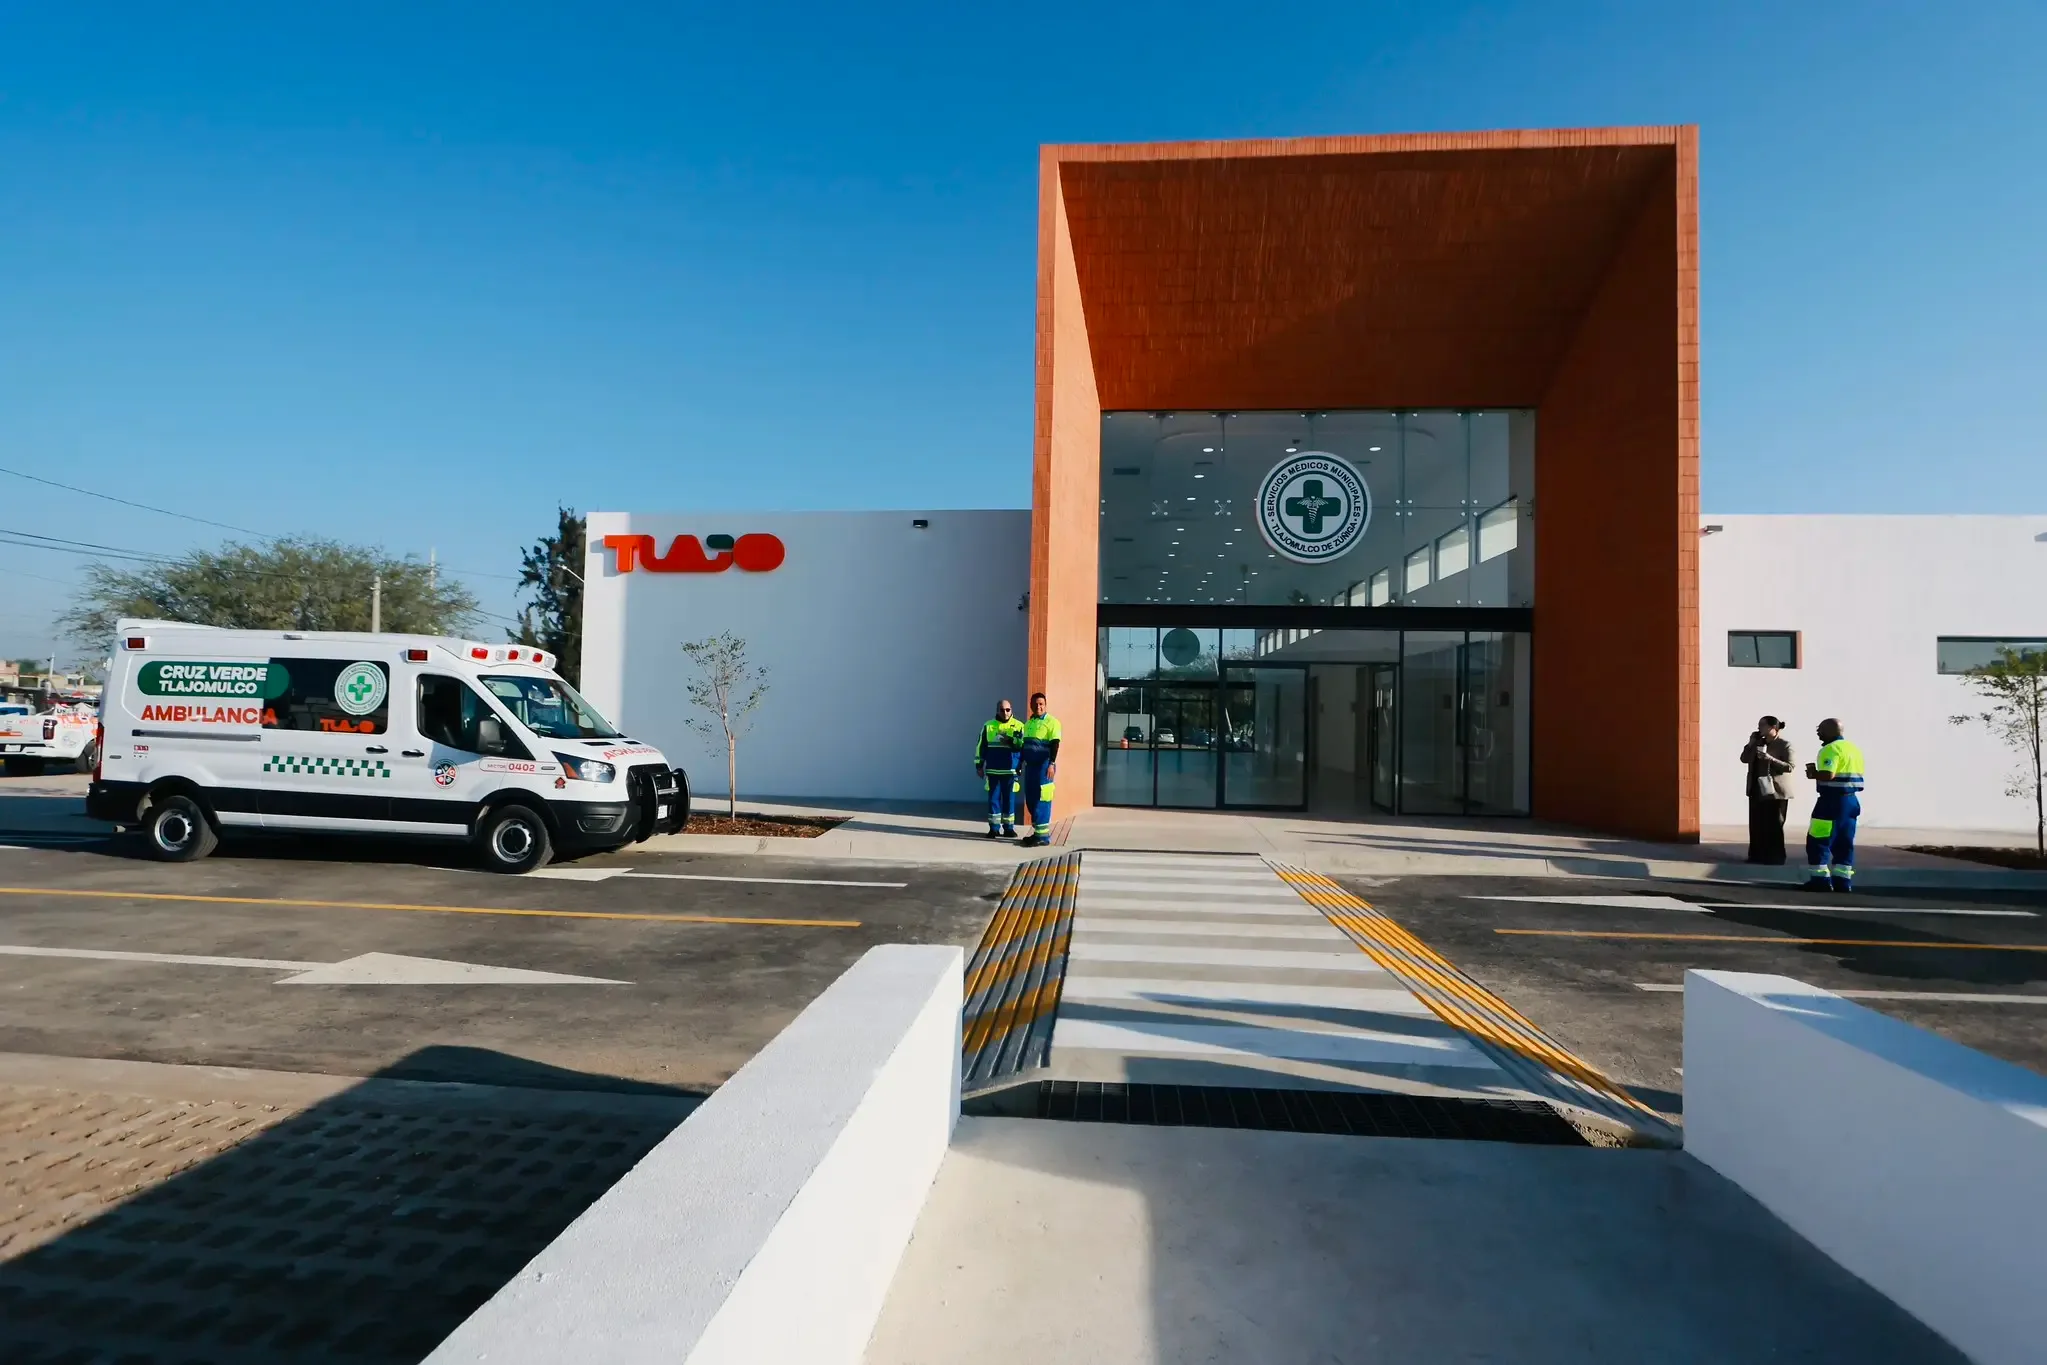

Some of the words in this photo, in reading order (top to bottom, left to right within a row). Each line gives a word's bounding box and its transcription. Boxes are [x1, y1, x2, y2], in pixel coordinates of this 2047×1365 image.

[1267, 473, 1288, 517] SERVICIOS
[1288, 461, 1329, 475] MÉDICOS
[1330, 466, 1361, 518] MUNICIPALES
[1272, 523, 1320, 553] TLAJOMULCO
[1321, 542, 1334, 552] DE
[1334, 522, 1357, 547] ZÚÑIGA
[159, 665, 206, 680] CRUZ
[209, 665, 267, 681] VERDE
[159, 680, 258, 694] TLAJOMULCO
[141, 704, 278, 726] AMBULANCIA
[508, 763, 535, 772] 0402
